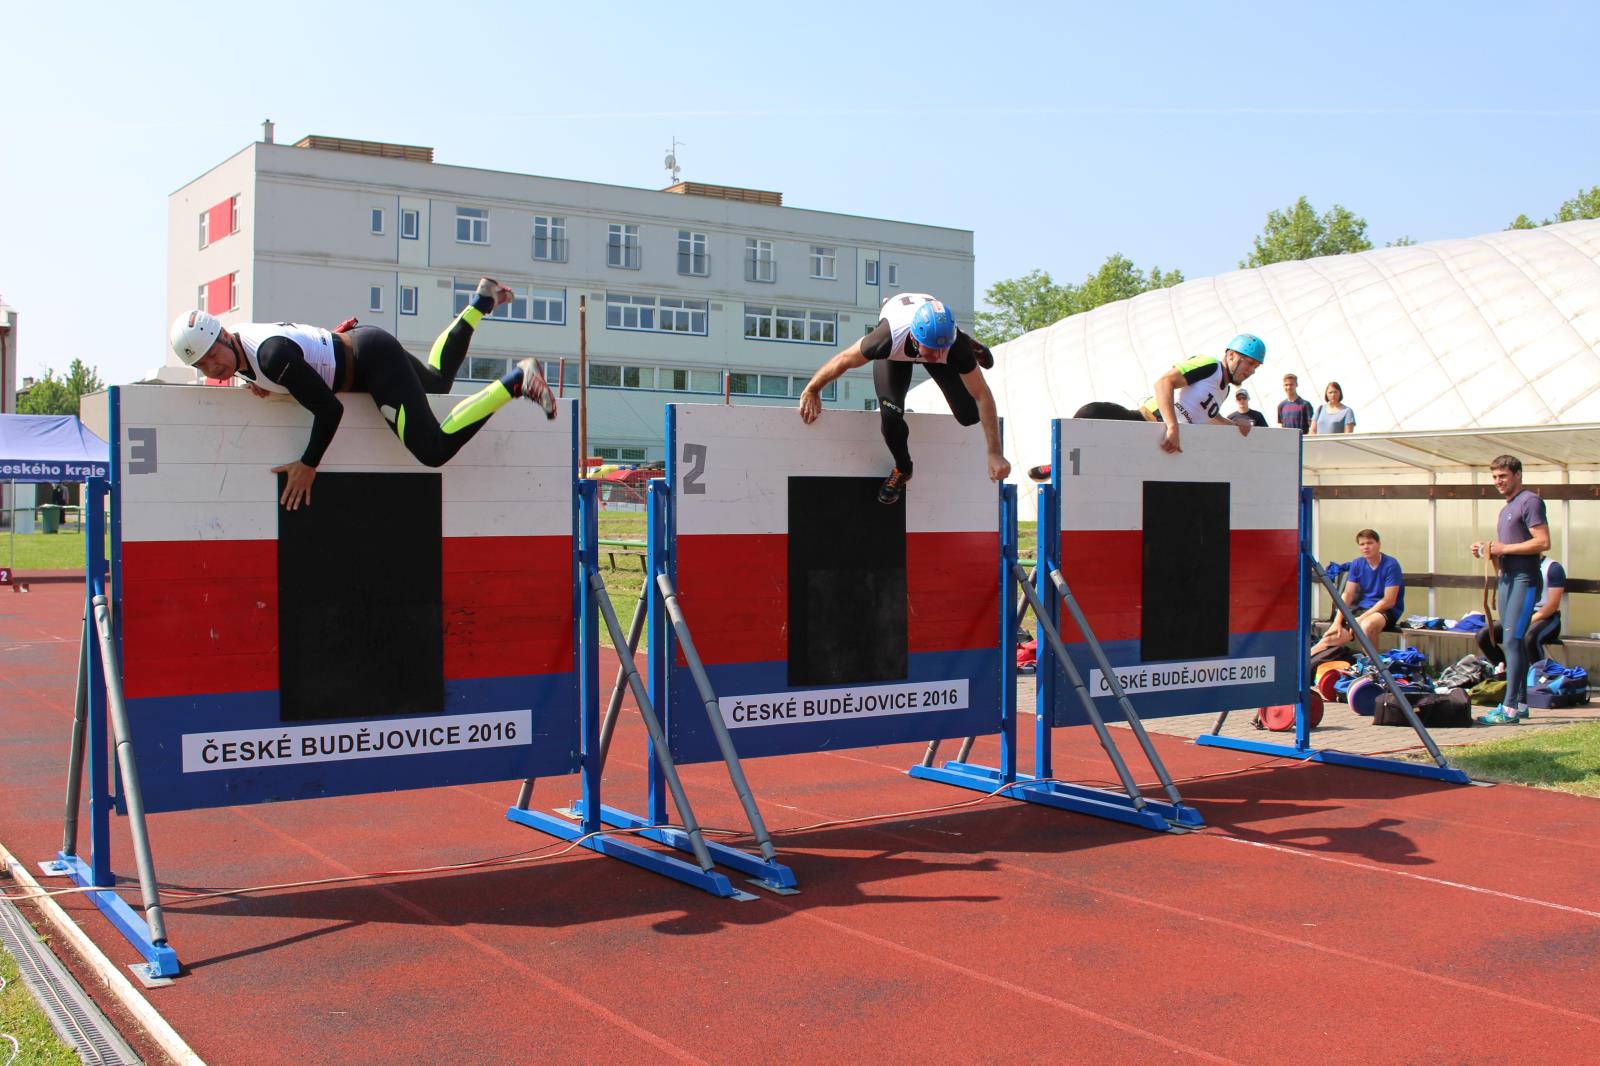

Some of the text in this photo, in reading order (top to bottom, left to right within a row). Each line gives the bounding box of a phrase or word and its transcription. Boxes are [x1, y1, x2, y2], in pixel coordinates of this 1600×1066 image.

[1200, 392, 1219, 418] 10
[128, 428, 157, 474] 3
[1070, 448, 1080, 475] 1
[65, 464, 105, 477] kraje
[683, 443, 707, 494] 2
[1, 571, 7, 581] 2
[1152, 667, 1237, 686] BUDĚJOVICE
[1240, 665, 1266, 680] 2016
[732, 689, 958, 722] ČESKÉ BUDĚJOVICE 2016
[201, 721, 517, 764] ČESKÉ BUDĚJOVICE 2016
